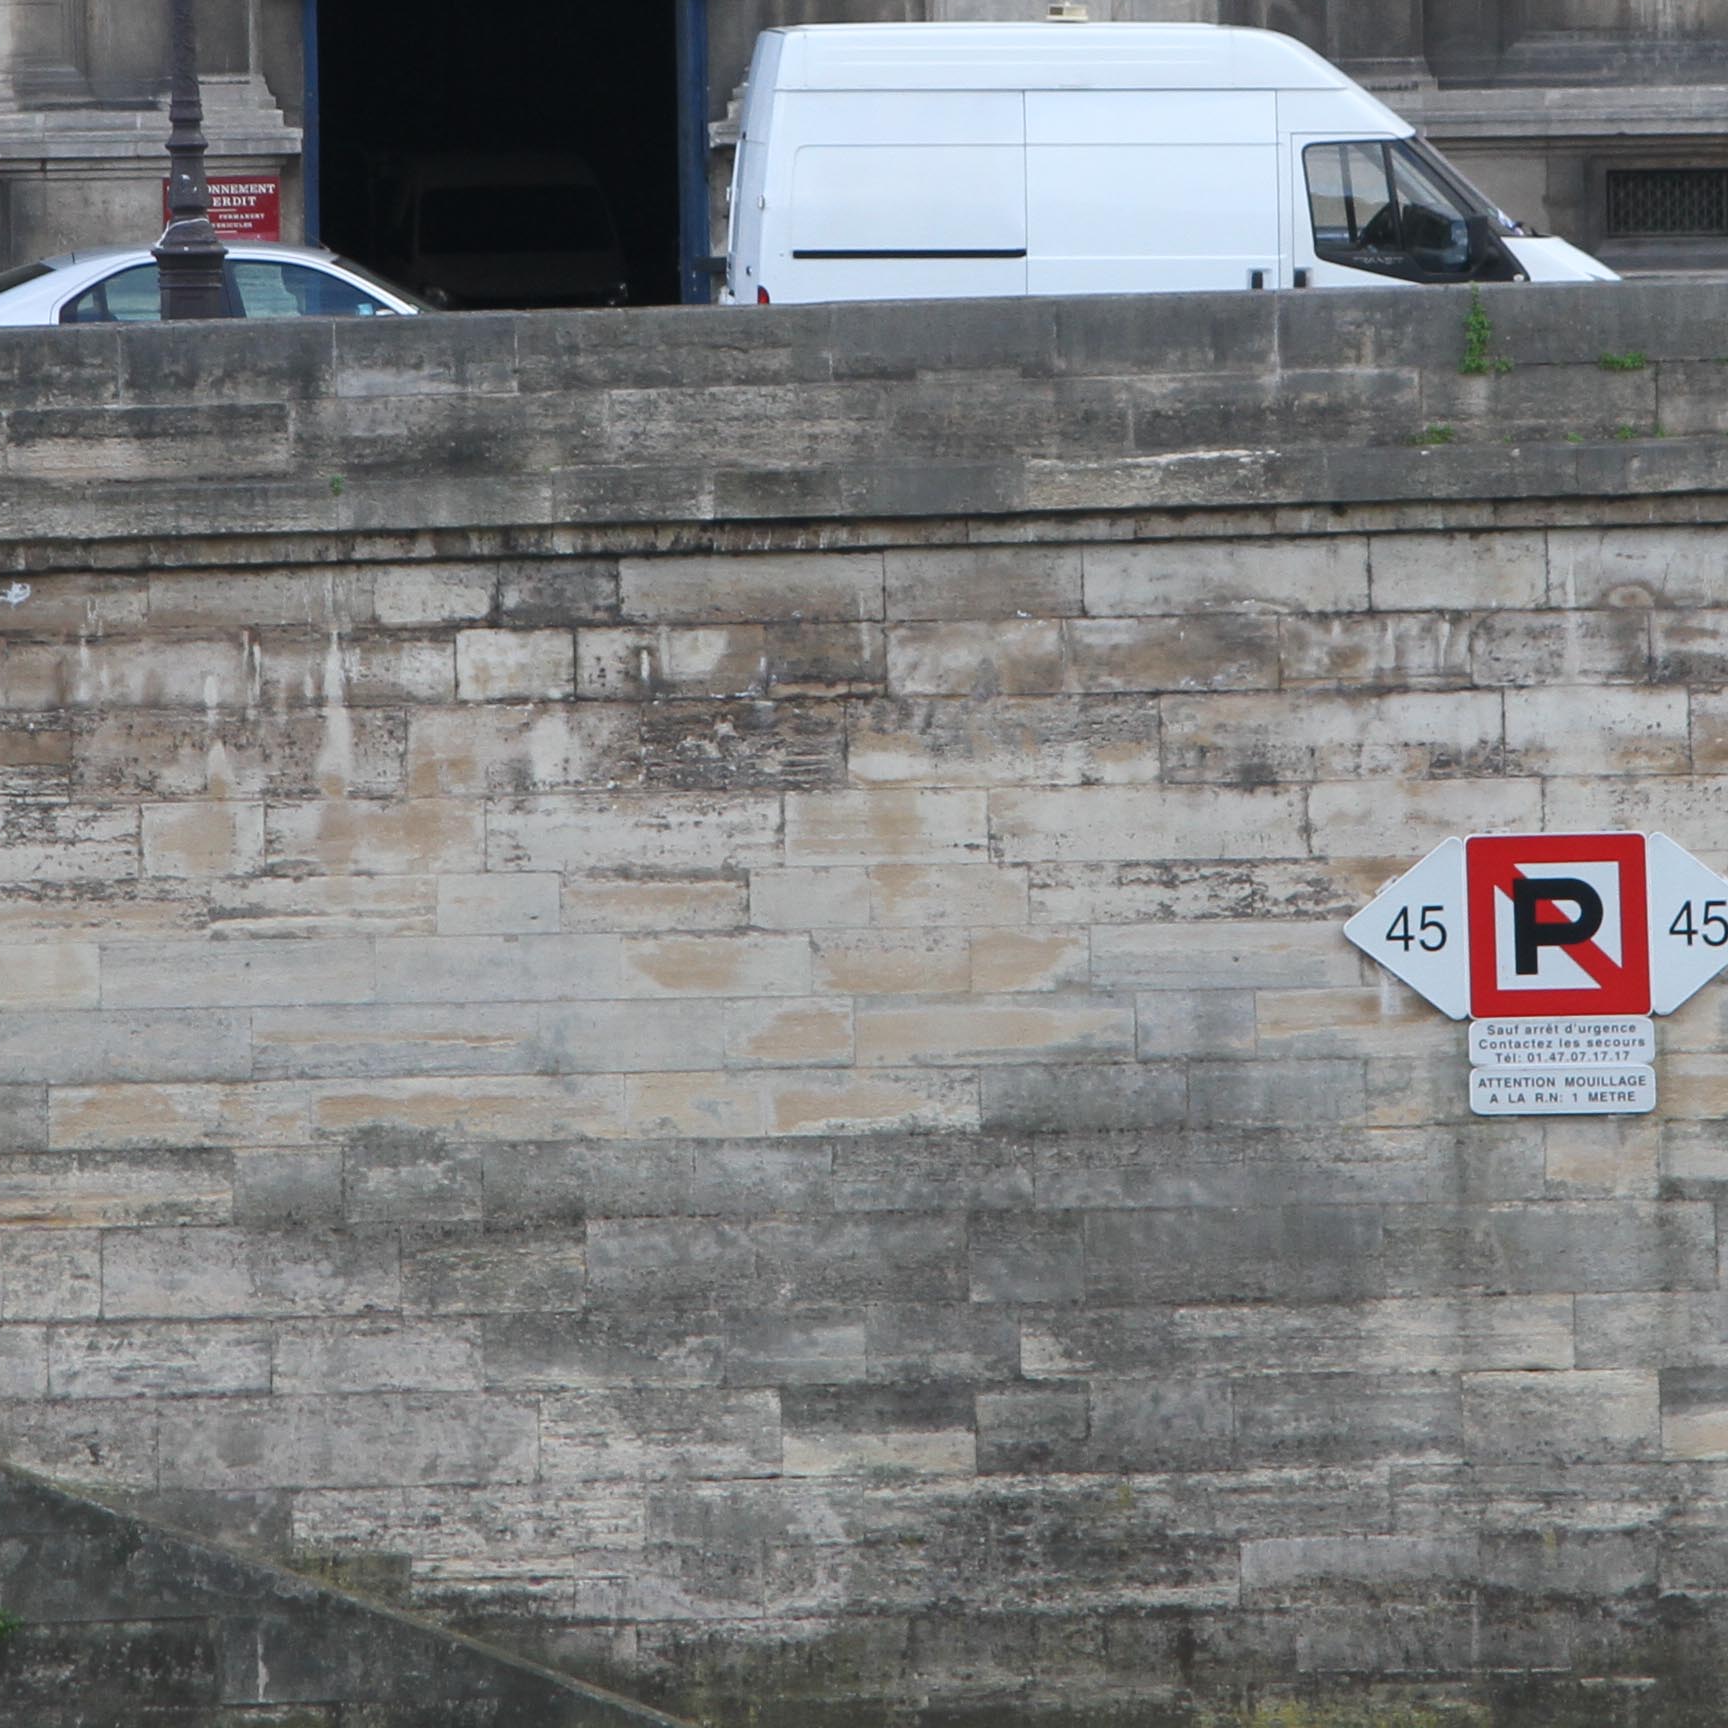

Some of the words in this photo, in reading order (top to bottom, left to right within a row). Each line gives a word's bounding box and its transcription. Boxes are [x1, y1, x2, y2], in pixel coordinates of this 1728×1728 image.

[212, 195, 257, 207] ERDIT
[1385, 905, 1447, 952] 45
[1512, 877, 1604, 976] P
[1487, 1024, 1519, 1035] Sauf
[1524, 1023, 1559, 1035] arrêt
[1564, 1023, 1637, 1037] d'urgence
[1478, 1038, 1553, 1050] Contactez
[1559, 1038, 1580, 1048] les
[1587, 1038, 1646, 1048] secours
[1527, 1050, 1630, 1063] 01.47.07.17.17
[1478, 1077, 1556, 1089] ATTENTION
[1564, 1075, 1647, 1087] MOUILLAGE
[1489, 1093, 1499, 1104] A
[1508, 1093, 1526, 1104] LA
[1571, 1092, 1578, 1102] 1
[1588, 1091, 1636, 1102] METRE
